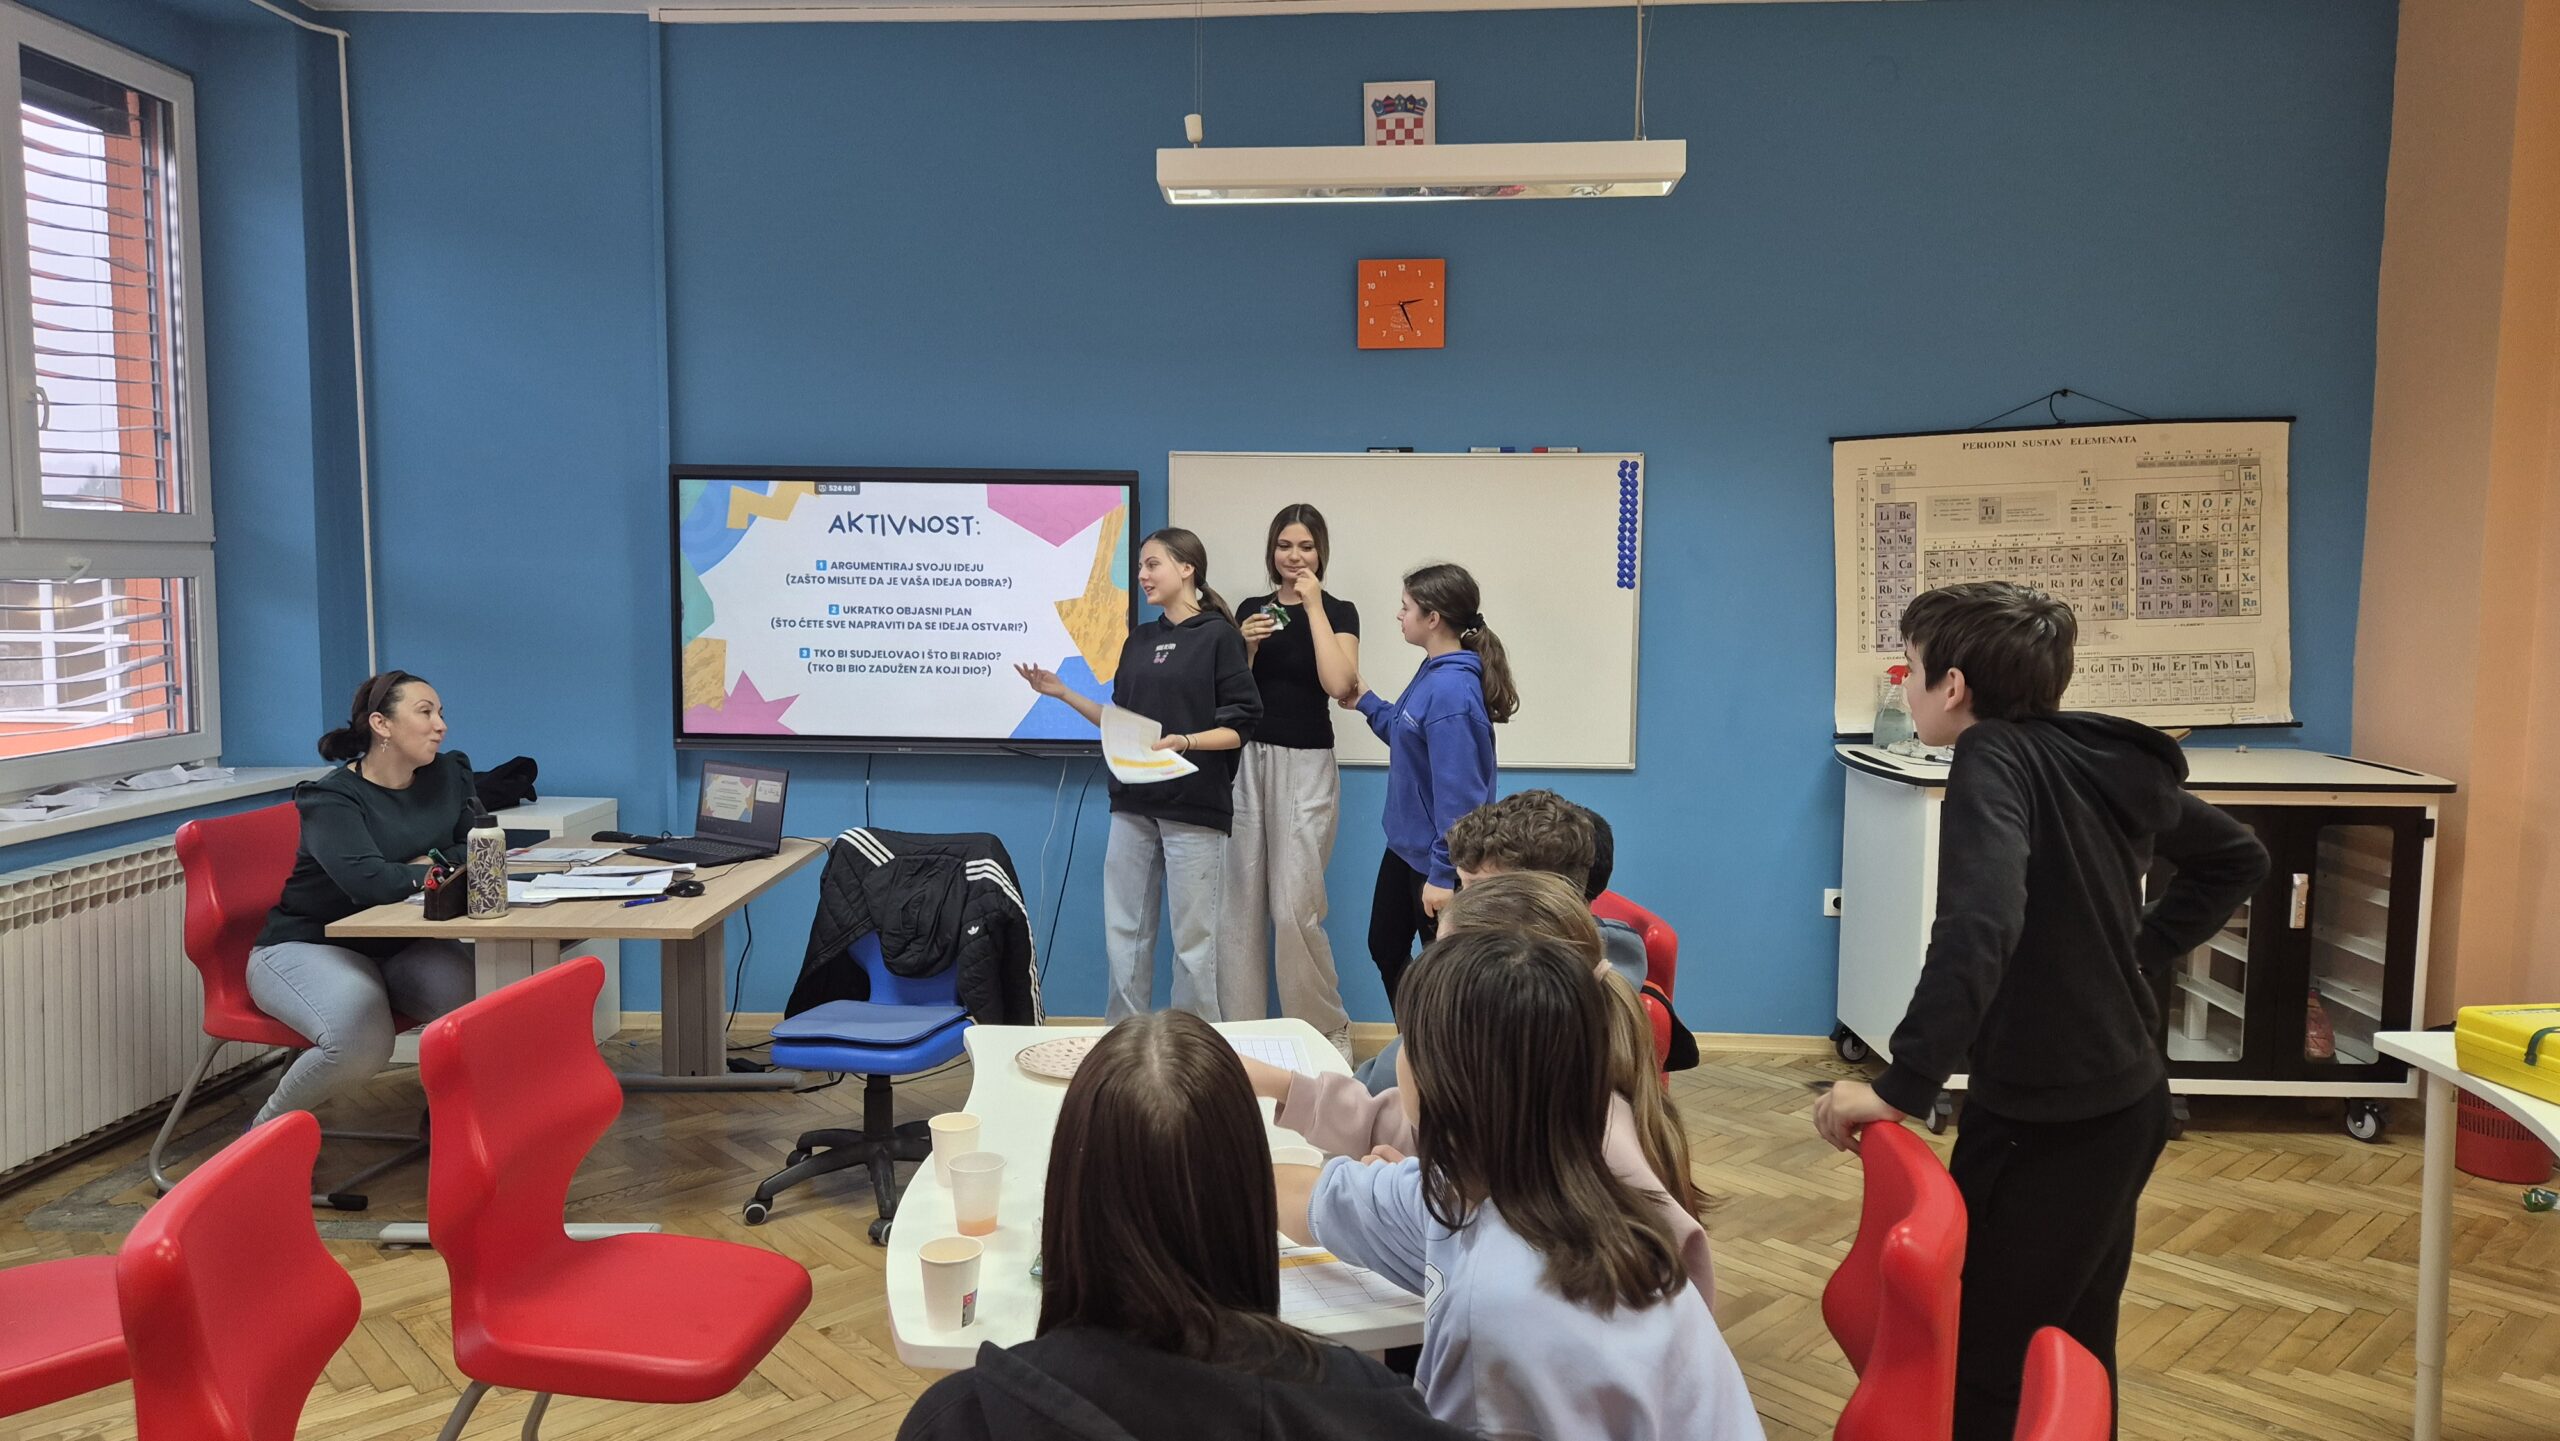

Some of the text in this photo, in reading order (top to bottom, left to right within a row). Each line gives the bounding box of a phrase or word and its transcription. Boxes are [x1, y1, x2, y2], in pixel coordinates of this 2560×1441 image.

[1962, 436, 2137, 450] PERIODNI SUSTAV ELEMENATA
[2244, 472, 2256, 480] He
[2083, 477, 2090, 486] H
[2142, 501, 2149, 510] B
[2161, 500, 2170, 509] C
[2182, 500, 2191, 508] N
[2202, 499, 2213, 508] O
[2224, 498, 2233, 507] F
[2244, 497, 2256, 506] Ne
[1982, 505, 1995, 515] Ti
[1880, 511, 1889, 520] Li
[1899, 511, 1911, 520] Be
[828, 511, 981, 537] AKTIVNOST:
[2202, 524, 2209, 533] S
[2221, 523, 2232, 532] Cl
[2242, 523, 2256, 532] Ar
[2140, 526, 2150, 535] Al
[2161, 526, 2170, 534] Si
[2182, 525, 2190, 533] P
[1879, 536, 1892, 545] Na
[1898, 535, 1912, 544] Mg
[2140, 551, 2153, 560] Ga
[2160, 550, 2173, 559] Ge
[2180, 550, 2193, 559] As
[2222, 548, 2234, 557] Br
[2242, 547, 2255, 556] Kr
[2008, 556, 2024, 565] Mn
[2031, 555, 2043, 564] Fe
[2050, 554, 2064, 563] Co
[2071, 554, 2082, 563] Ni
[2090, 553, 2104, 562] Cu
[2111, 552, 2124, 561] Zn
[1882, 561, 1890, 569] K
[1899, 560, 1912, 569] Ca
[1947, 558, 1958, 567] Ti
[1969, 557, 1978, 566] V
[1988, 557, 2002, 566] Cr
[831, 561, 913, 571] ARGUMENTIRAJ
[916, 562, 951, 572] SVOJU
[954, 563, 984, 573] IDEJU
[786, 573, 1012, 589] (ZAŠTO MISLITE DA JE VAŠA IDEJA DOBRA?)
[2110, 577, 2123, 586] Cd
[2141, 576, 2152, 585] In
[2160, 575, 2172, 584] Sn
[2181, 575, 2193, 584] Sb
[2201, 574, 2213, 583] Te
[2242, 573, 2255, 582] Xe
[2051, 580, 2064, 588] Rh
[2071, 578, 2083, 587] Pd
[2091, 578, 2104, 587] Ag
[1879, 585, 1892, 594] Rb
[1900, 584, 1912, 593] Sr
[2111, 601, 2125, 611] Hg
[2140, 601, 2151, 610] Tl
[2160, 600, 2173, 609] Pb
[2182, 600, 2192, 609] Bi
[2201, 599, 2213, 608] Po
[2222, 599, 2233, 608] At
[2243, 598, 2257, 607] Rn
[843, 605, 894, 615] UKRATKO
[896, 607, 942, 616] OBJASNI
[945, 608, 972, 616] PLAN
[2073, 603, 2083, 612] Pt
[2092, 603, 2105, 612] Au
[1880, 610, 1892, 619] Cs
[771, 617, 1028, 633] (ŠTO ĆETE SVE NAPRAVITI DA SE IDEJA OSTVARI?)
[1880, 634, 1892, 642] Fr
[814, 649, 836, 658] TKO
[838, 649, 848, 658] BI
[850, 649, 919, 659] SUDJELOVAO
[927, 649, 948, 659] ŠTO
[950, 651, 960, 660] BI
[963, 652, 1001, 660] RADIO?
[2090, 664, 2104, 673] Gd
[2110, 664, 2124, 673] Tb
[2132, 663, 2144, 674] Dy
[2152, 662, 2165, 671] Ho
[2173, 661, 2186, 671] Er
[2192, 661, 2208, 670] Tm
[2214, 660, 2228, 670] Yb
[2236, 659, 2251, 669] Lu
[808, 662, 991, 677] (TKO BI BIO ZADUŽEN ZA KOJI DIO?)
